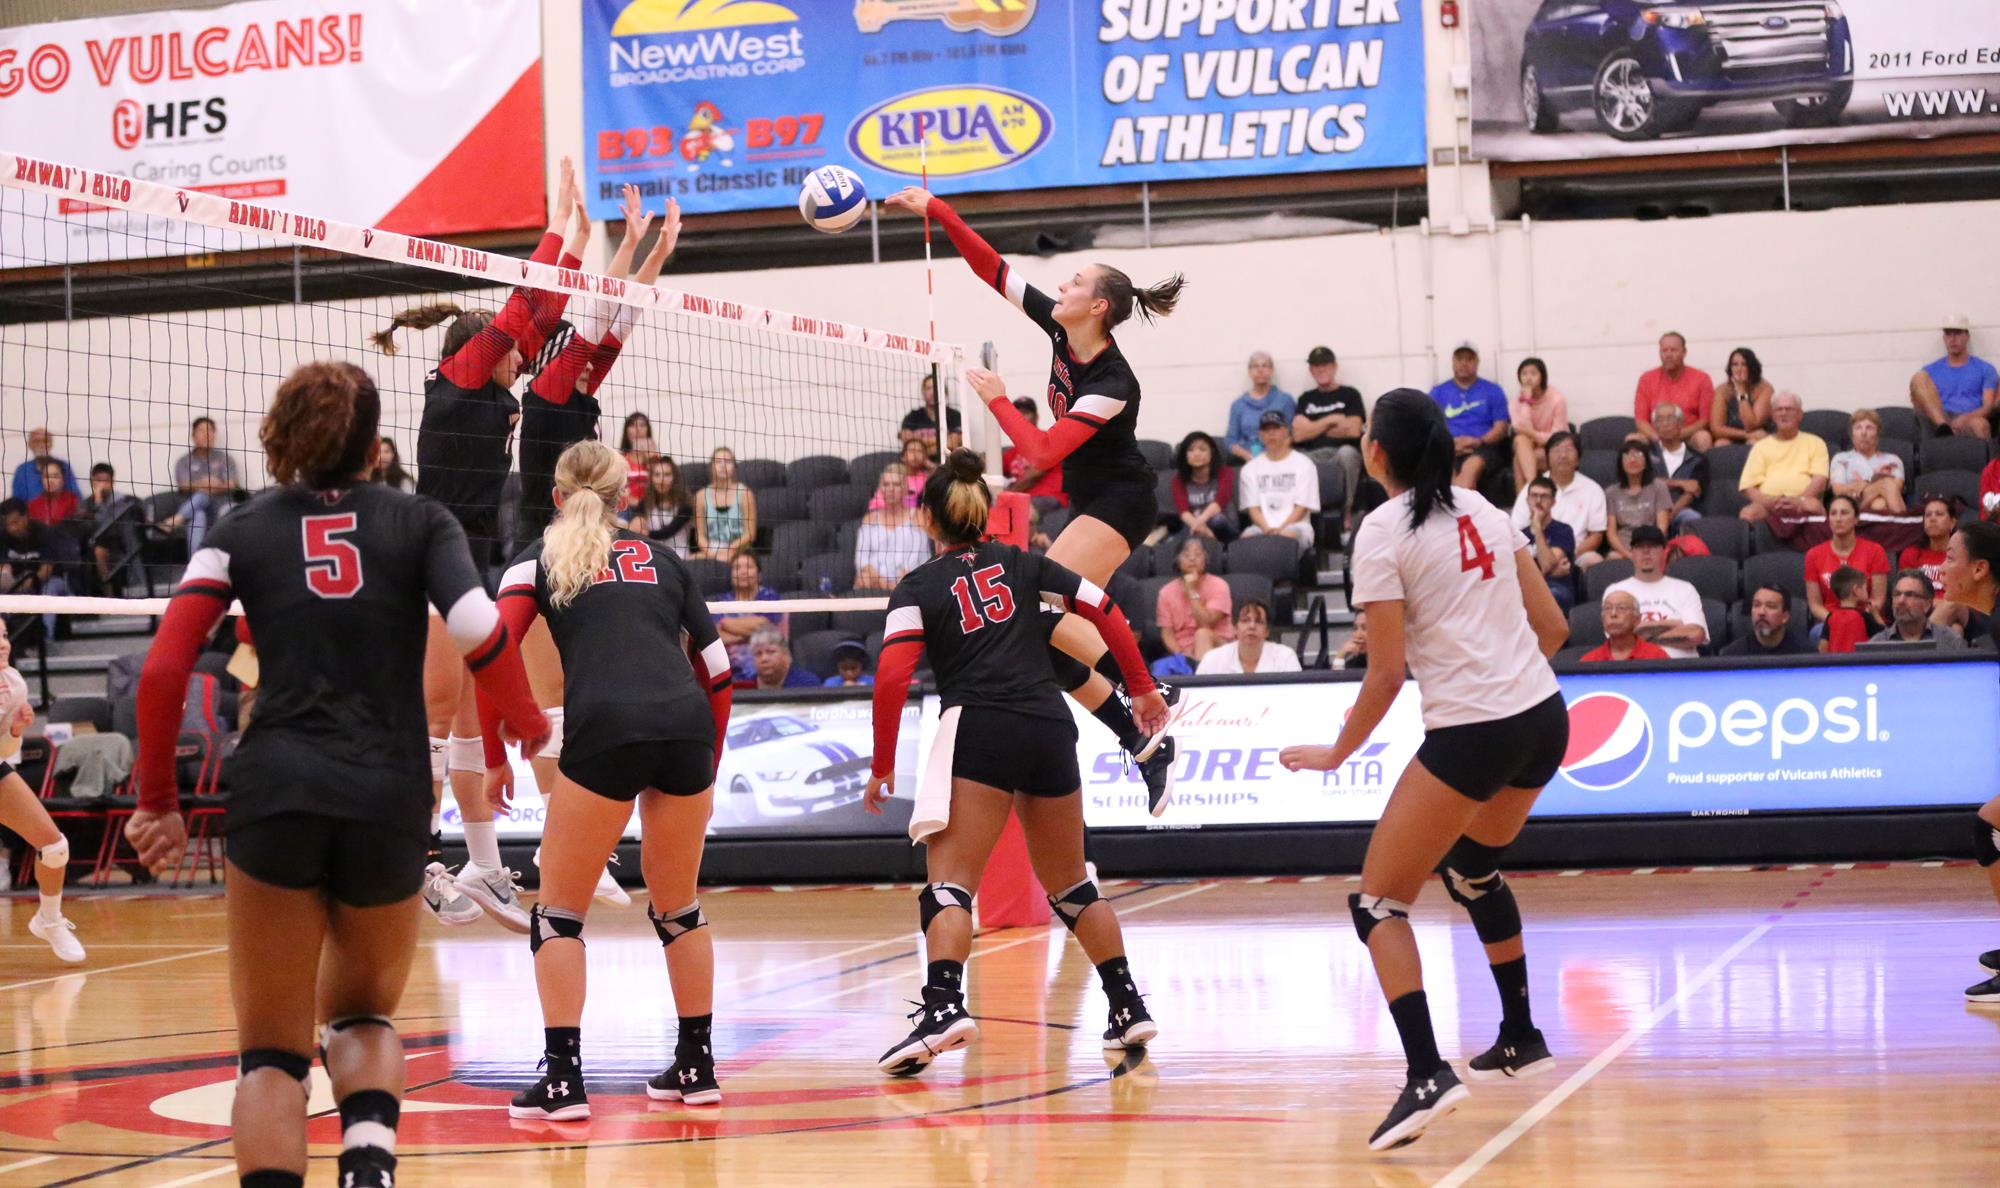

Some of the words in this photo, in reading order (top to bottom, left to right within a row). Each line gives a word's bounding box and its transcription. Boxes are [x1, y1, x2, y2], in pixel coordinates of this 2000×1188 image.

[1098, 0, 1400, 42] SUPPORTER
[0, 43, 70, 97] GO
[86, 14, 363, 87] VULCANS!
[609, 26, 804, 71] NewWest
[1869, 52, 1912, 69] 2011
[1921, 49, 1968, 66] Ford
[1976, 47, 2000, 64] Ed
[609, 62, 749, 87] BROADCASTING
[752, 57, 806, 75] CORP
[1102, 54, 1170, 103] OF
[1182, 39, 1384, 99] VULCAN
[1001, 105, 1024, 115] AM
[1882, 88, 1998, 117] www.
[146, 98, 228, 139] HFS
[746, 113, 824, 148] B97
[878, 104, 1015, 154] KPUA
[597, 126, 673, 160] B93
[1100, 104, 1368, 167] ATHLETICS
[132, 159, 201, 183] Caring
[208, 154, 287, 176] Counts
[695, 169, 776, 193] Classic
[783, 166, 811, 187] Hit
[92, 173, 131, 203] HILO
[294, 215, 327, 241] HILO
[461, 250, 488, 273] HILO
[602, 277, 626, 298] HILO
[302, 511, 364, 599] 5
[1456, 514, 1496, 581] 4
[950, 563, 1016, 635] 15
[810, 706, 920, 721] fordhawm
[1668, 682, 1880, 763] pepsi
[1667, 771, 1704, 784] Proud
[1705, 770, 1764, 785] supporter
[1767, 769, 1780, 781] of
[1781, 769, 1827, 780] Vulcans
[1830, 767, 1882, 780] Athletics
[510, 807, 546, 822] ORC
[1092, 792, 1259, 809] SCHOARSHIPS
[1690, 808, 1750, 817] DAKTRONICS
